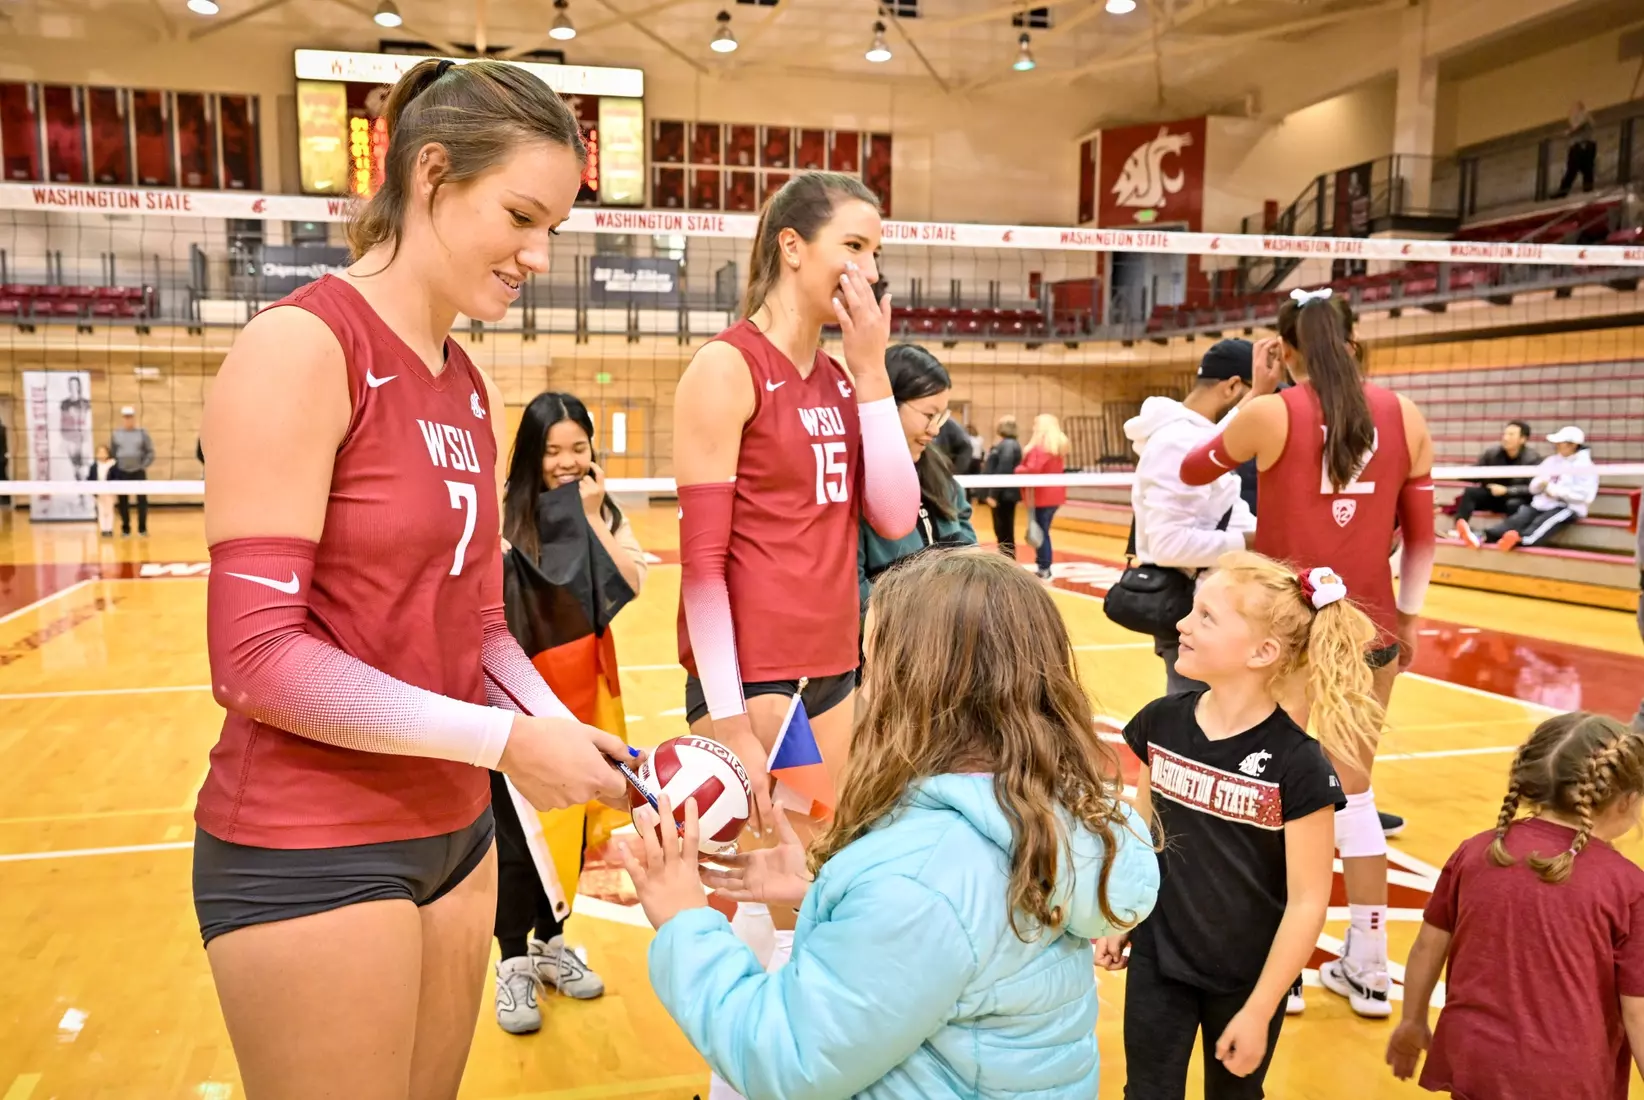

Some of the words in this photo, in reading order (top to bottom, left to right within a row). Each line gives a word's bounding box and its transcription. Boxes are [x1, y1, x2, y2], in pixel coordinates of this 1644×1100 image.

[32, 186, 140, 209] WASHINGTON
[146, 192, 192, 212] STATE
[594, 211, 683, 230] WASHINGTON
[687, 215, 725, 232] STATE
[880, 223, 918, 240] NGTON
[922, 225, 957, 241] STATE
[1060, 231, 1133, 247] WASHINGTON
[1136, 232, 1169, 248] STATE
[1262, 238, 1331, 253] WASHINGTON
[1334, 240, 1363, 254] STATE
[797, 406, 846, 437] WSU
[415, 418, 481, 474] WSU
[810, 441, 849, 505] 15
[443, 479, 478, 576] 7
[690, 739, 752, 797] molten
[1151, 753, 1216, 805] WASHINGTON
[1214, 779, 1260, 818] STATE
